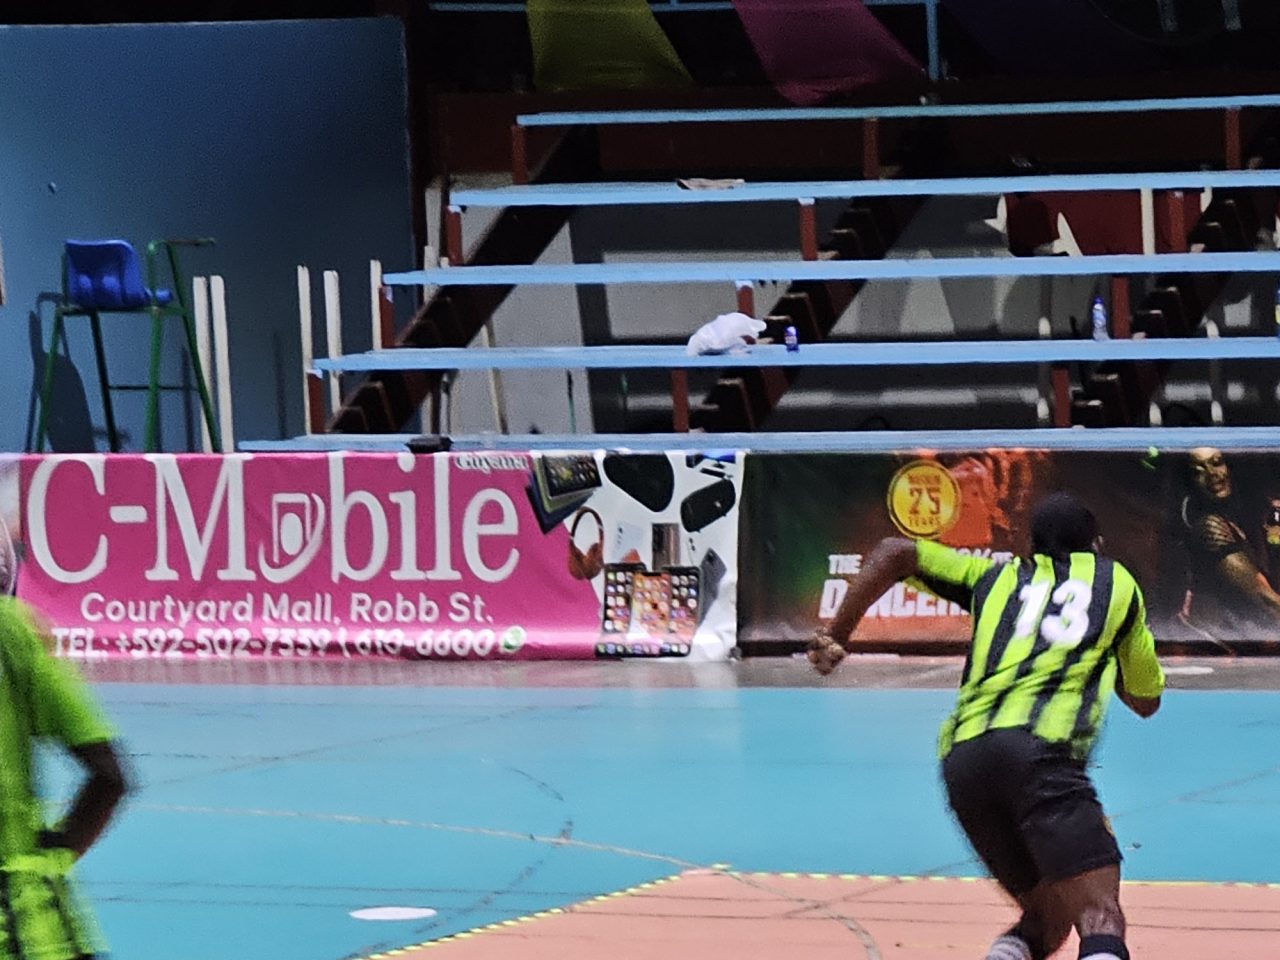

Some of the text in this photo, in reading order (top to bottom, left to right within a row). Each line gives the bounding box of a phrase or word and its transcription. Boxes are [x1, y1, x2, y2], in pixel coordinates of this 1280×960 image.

[80, 592, 494, 627] Courtyard Mall, Robb St.
[1015, 579, 1090, 644] 13
